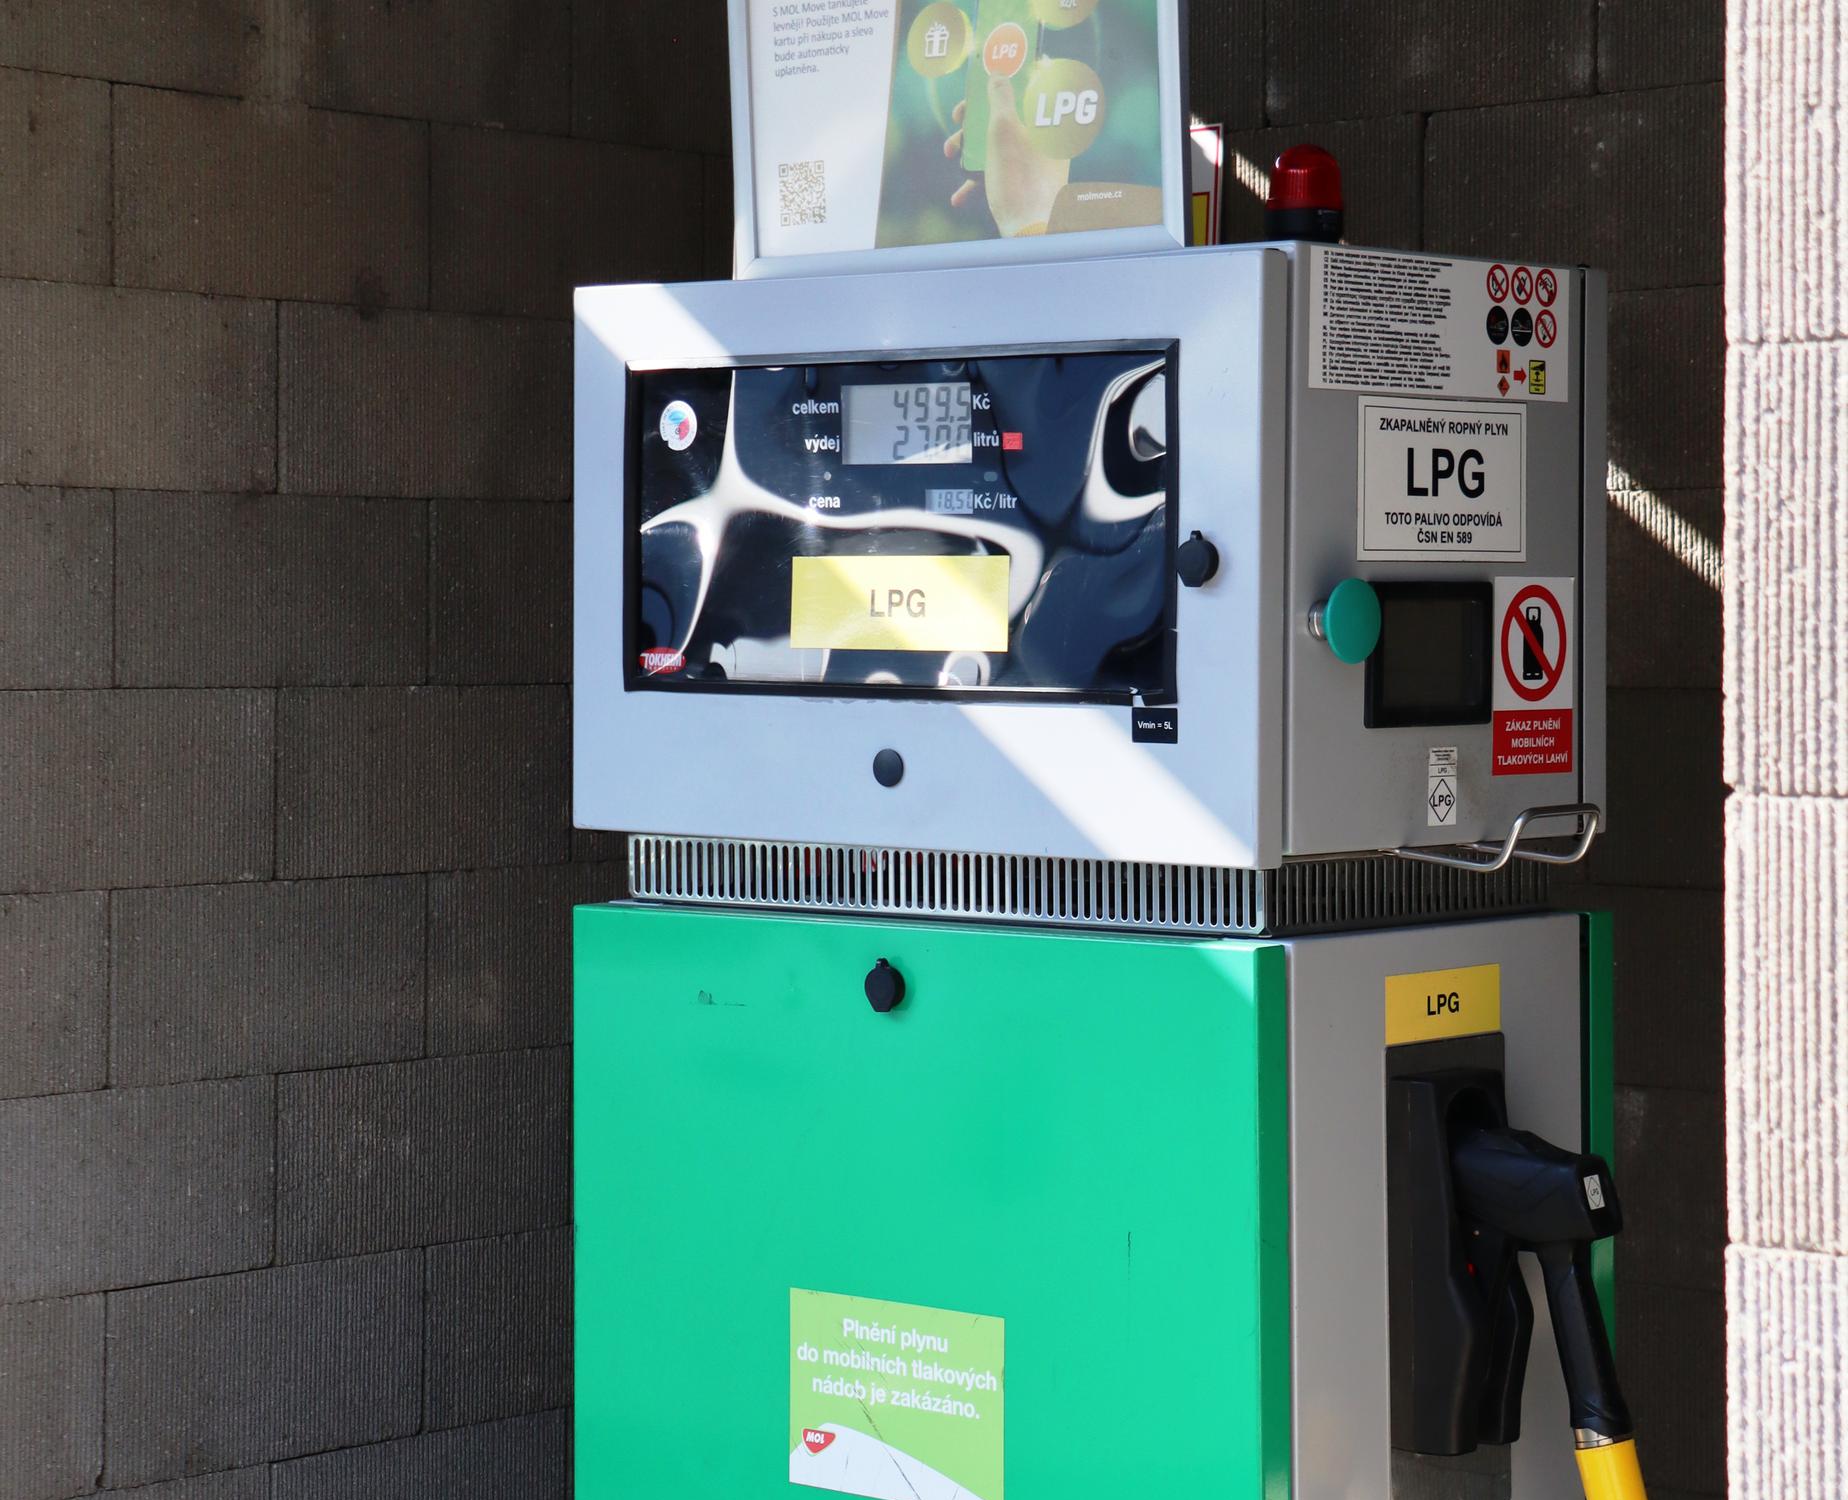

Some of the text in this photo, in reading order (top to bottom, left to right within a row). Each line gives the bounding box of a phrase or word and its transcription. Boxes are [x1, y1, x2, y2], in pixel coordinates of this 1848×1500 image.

[772, 6, 778, 17] S
[780, 4, 799, 16] MOL
[801, 2, 826, 13] Move
[841, 11, 862, 23] MOL
[864, 8, 889, 20] Move
[774, 36, 796, 47] kartu
[844, 30, 850, 38] a
[851, 26, 873, 38] sleva
[774, 44, 850, 62] bude automaticky
[991, 43, 1019, 60] LPG
[1034, 89, 1099, 127] LPG
[1076, 190, 1123, 201] molmove.cz
[792, 400, 840, 415] celkem
[972, 393, 991, 410] Kč
[1379, 417, 1509, 437] ZKAPALNĚNÝ ROPNÝ PLYN
[804, 434, 840, 453] výdej
[973, 430, 1000, 447] litrů
[1407, 447, 1485, 499] LPG
[809, 496, 841, 509] cena
[974, 493, 1018, 512] Kč/litr
[1385, 511, 1503, 528] TOTO PALIVO ODPOVÍDÁ
[1416, 527, 1473, 544] ČSN EN 589
[870, 588, 926, 618] LPG
[1137, 721, 1156, 729] Vmin
[1163, 721, 1173, 730] 5L
[1505, 716, 1561, 732] ZÁKAZ PLNĚNÍ
[1511, 734, 1555, 749] MOBILNÍCH
[1497, 750, 1569, 766] TLAKOVÝCH LAHVÍ
[1432, 794, 1452, 808] LPG
[1426, 991, 1460, 1016] LPG
[842, 1318, 949, 1353] Plnění plynu
[797, 1342, 998, 1392] do mobilních tlakových
[812, 1375, 981, 1420] nádob je zakázáno.
[805, 1431, 826, 1445] MOL
